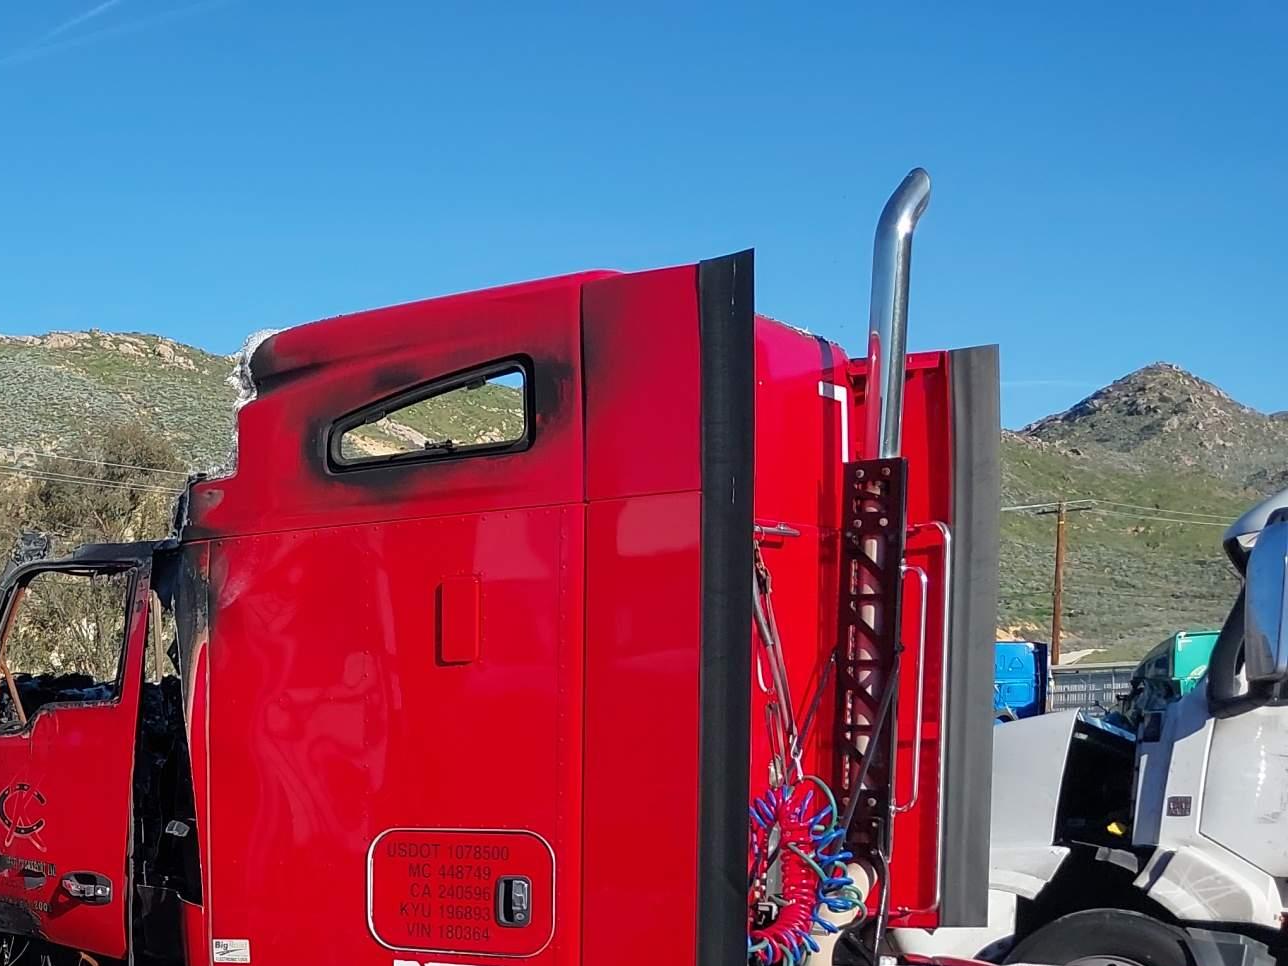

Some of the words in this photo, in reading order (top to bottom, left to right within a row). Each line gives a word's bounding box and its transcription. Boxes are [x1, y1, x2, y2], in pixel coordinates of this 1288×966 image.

[387, 842, 440, 858] USDOT
[448, 845, 509, 861] 1078500
[408, 864, 431, 878] MC
[438, 866, 492, 881] 448749
[410, 882, 431, 897] CA
[438, 886, 491, 901] 240596
[399, 902, 431, 918] KYU
[439, 905, 491, 921] 196893
[406, 923, 431, 938] VIN
[439, 926, 490, 941] 180364
